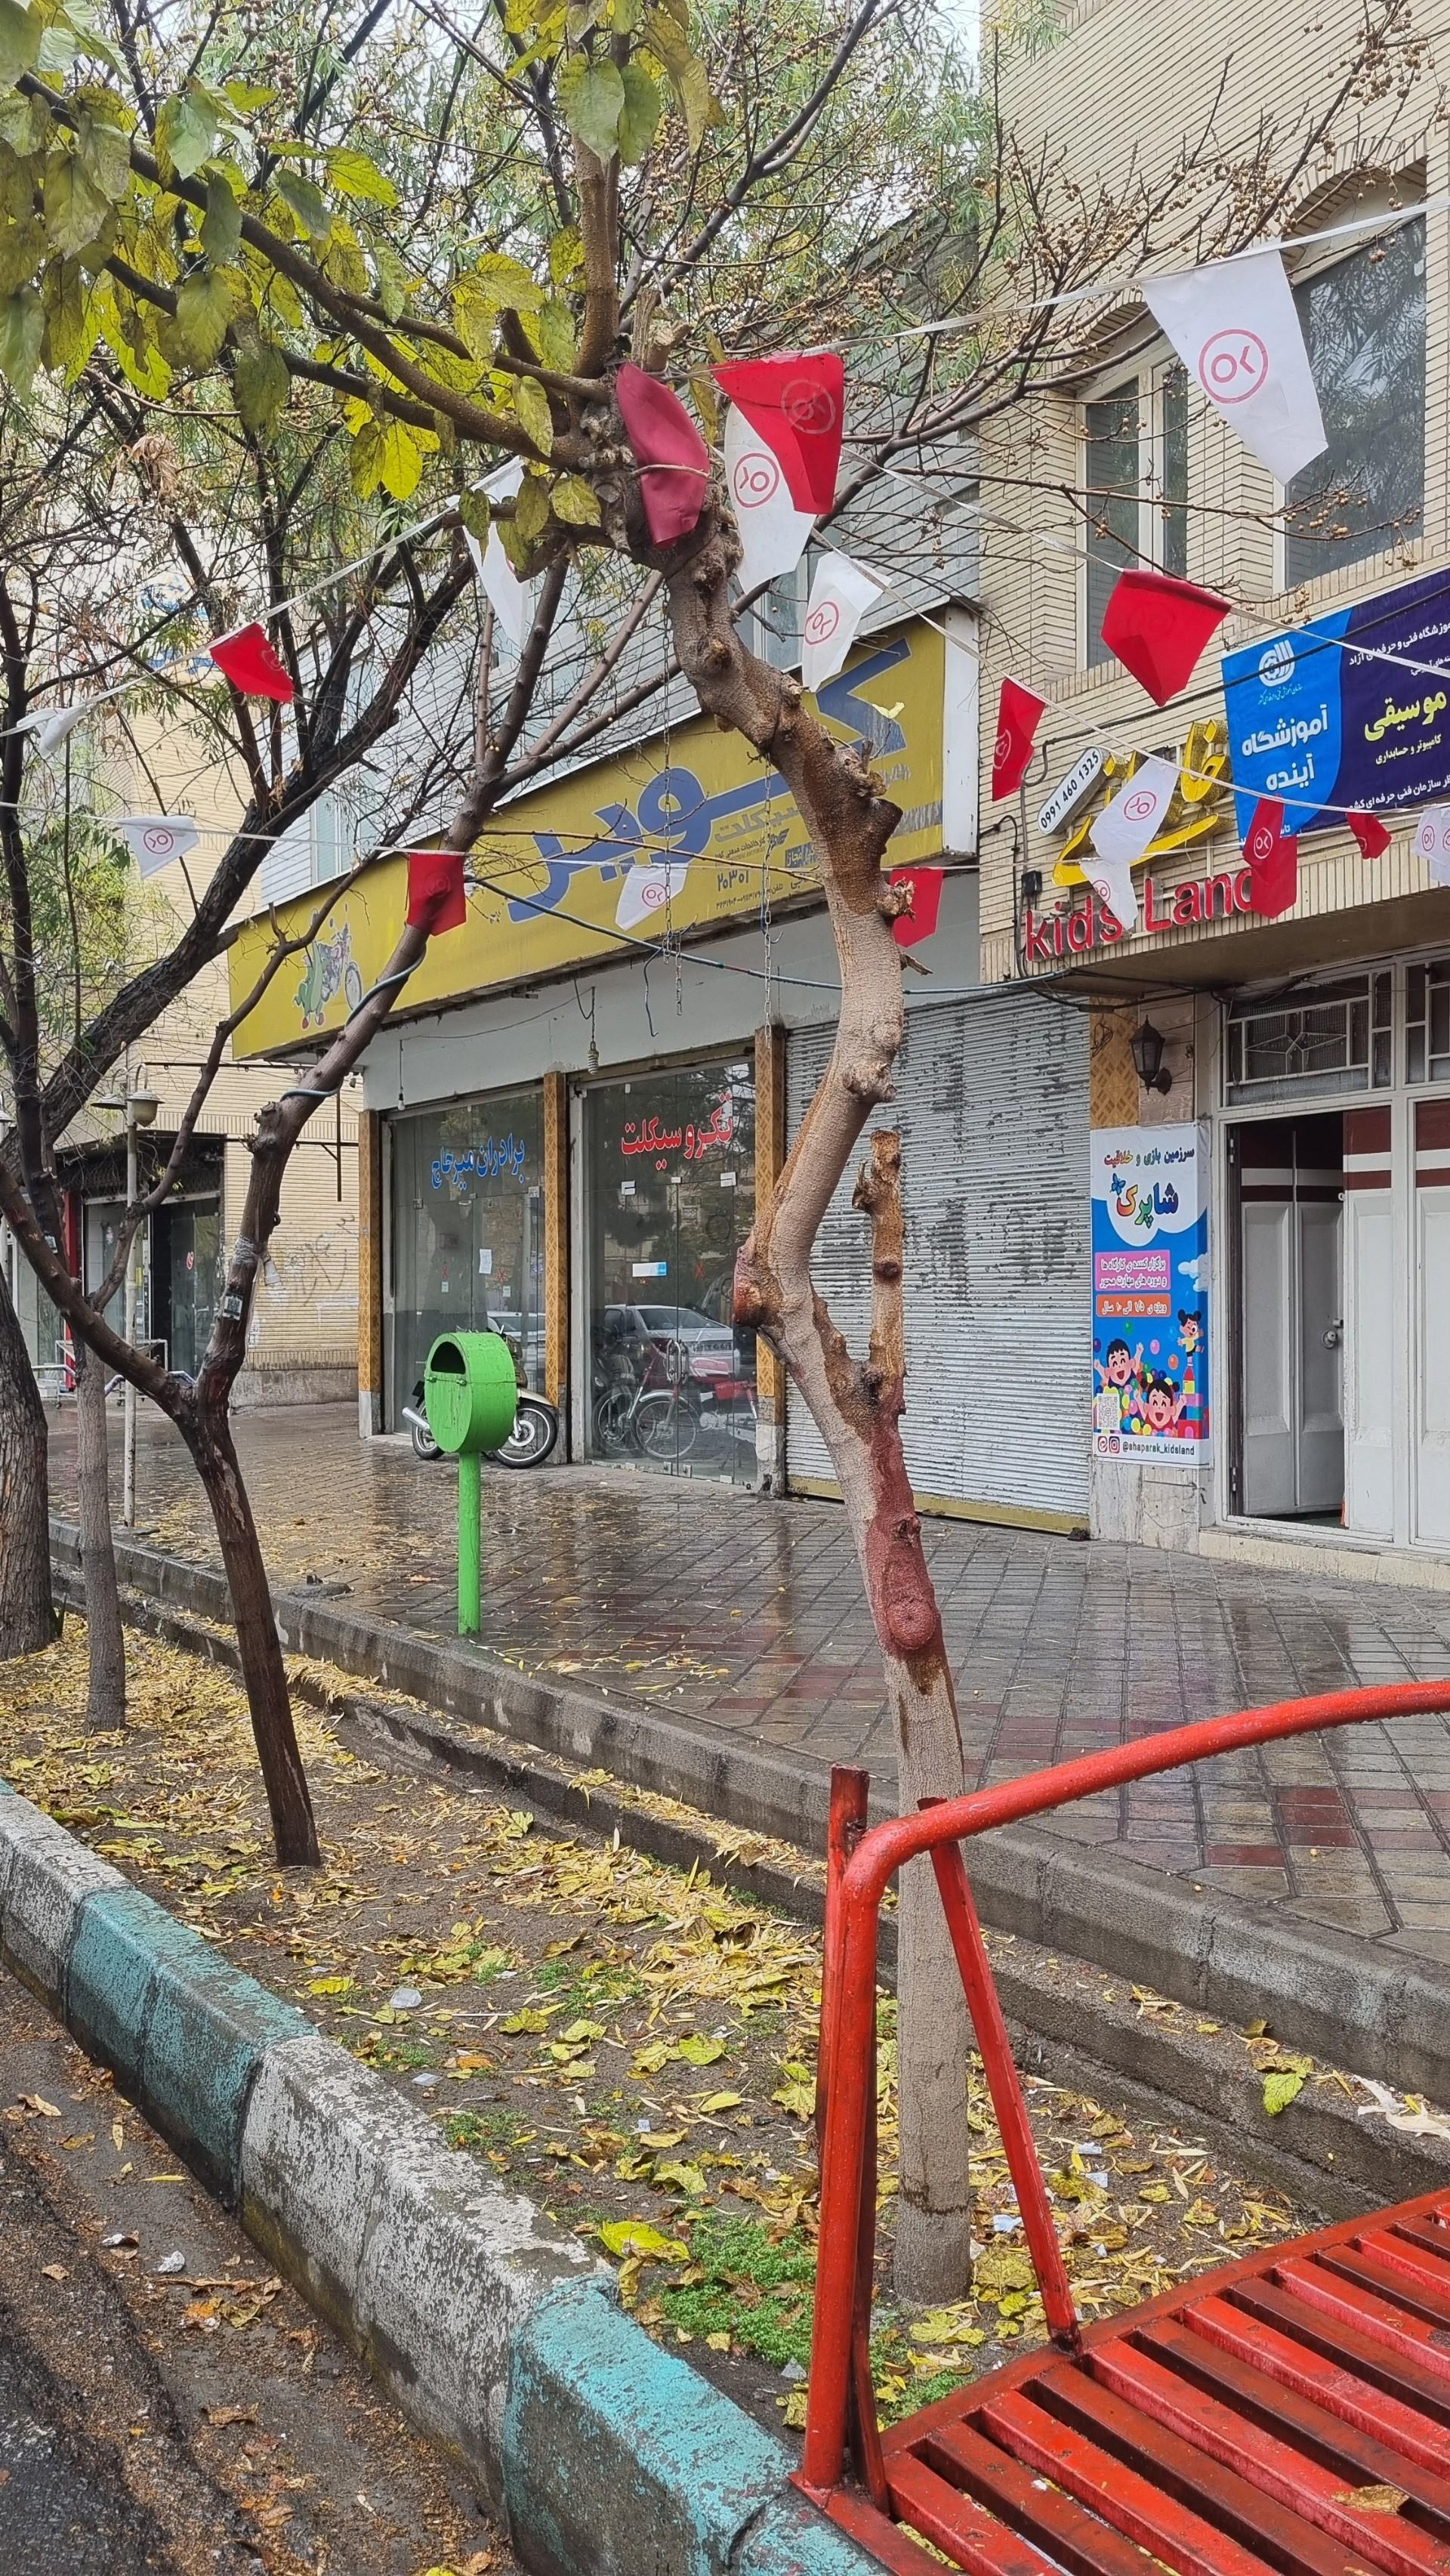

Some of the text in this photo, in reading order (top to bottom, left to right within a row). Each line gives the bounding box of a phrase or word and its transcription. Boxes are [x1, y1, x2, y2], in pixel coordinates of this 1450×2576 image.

[1397, 641, 1402, 650] و
[1402, 632, 1418, 647] فنی
[1365, 691, 1447, 741] موسیقی
[1242, 704, 1328, 756] آموزشگاه
[1375, 734, 1442, 765] کامپیوتر و حسابداری
[1266, 753, 1315, 791] آینده
[1041, 751, 1099, 829] 0991 460 1325
[1397, 785, 1412, 800] فنی
[1413, 779, 1441, 795] سازمان
[714, 806, 798, 843] یکلت
[1026, 895, 1125, 962] kids
[622, 1116, 682, 1171] سیکلت
[432, 1132, 525, 1191] برادران میرحاج
[1103, 1147, 1195, 1169] سرزمین بازی و خلاقیت
[1116, 1181, 1179, 1229] شاپرک
[1148, 1255, 1166, 1271] برگزار
[1100, 1277, 1115, 1289] محور
[1116, 1274, 1134, 1288] مهارت
[1162, 1277, 1167, 1288] و
[1102, 1300, 1114, 1314] سال
[1122, 1300, 1133, 1314] الی
[1122, 1441, 1195, 1456] @shaparak_kidsland
